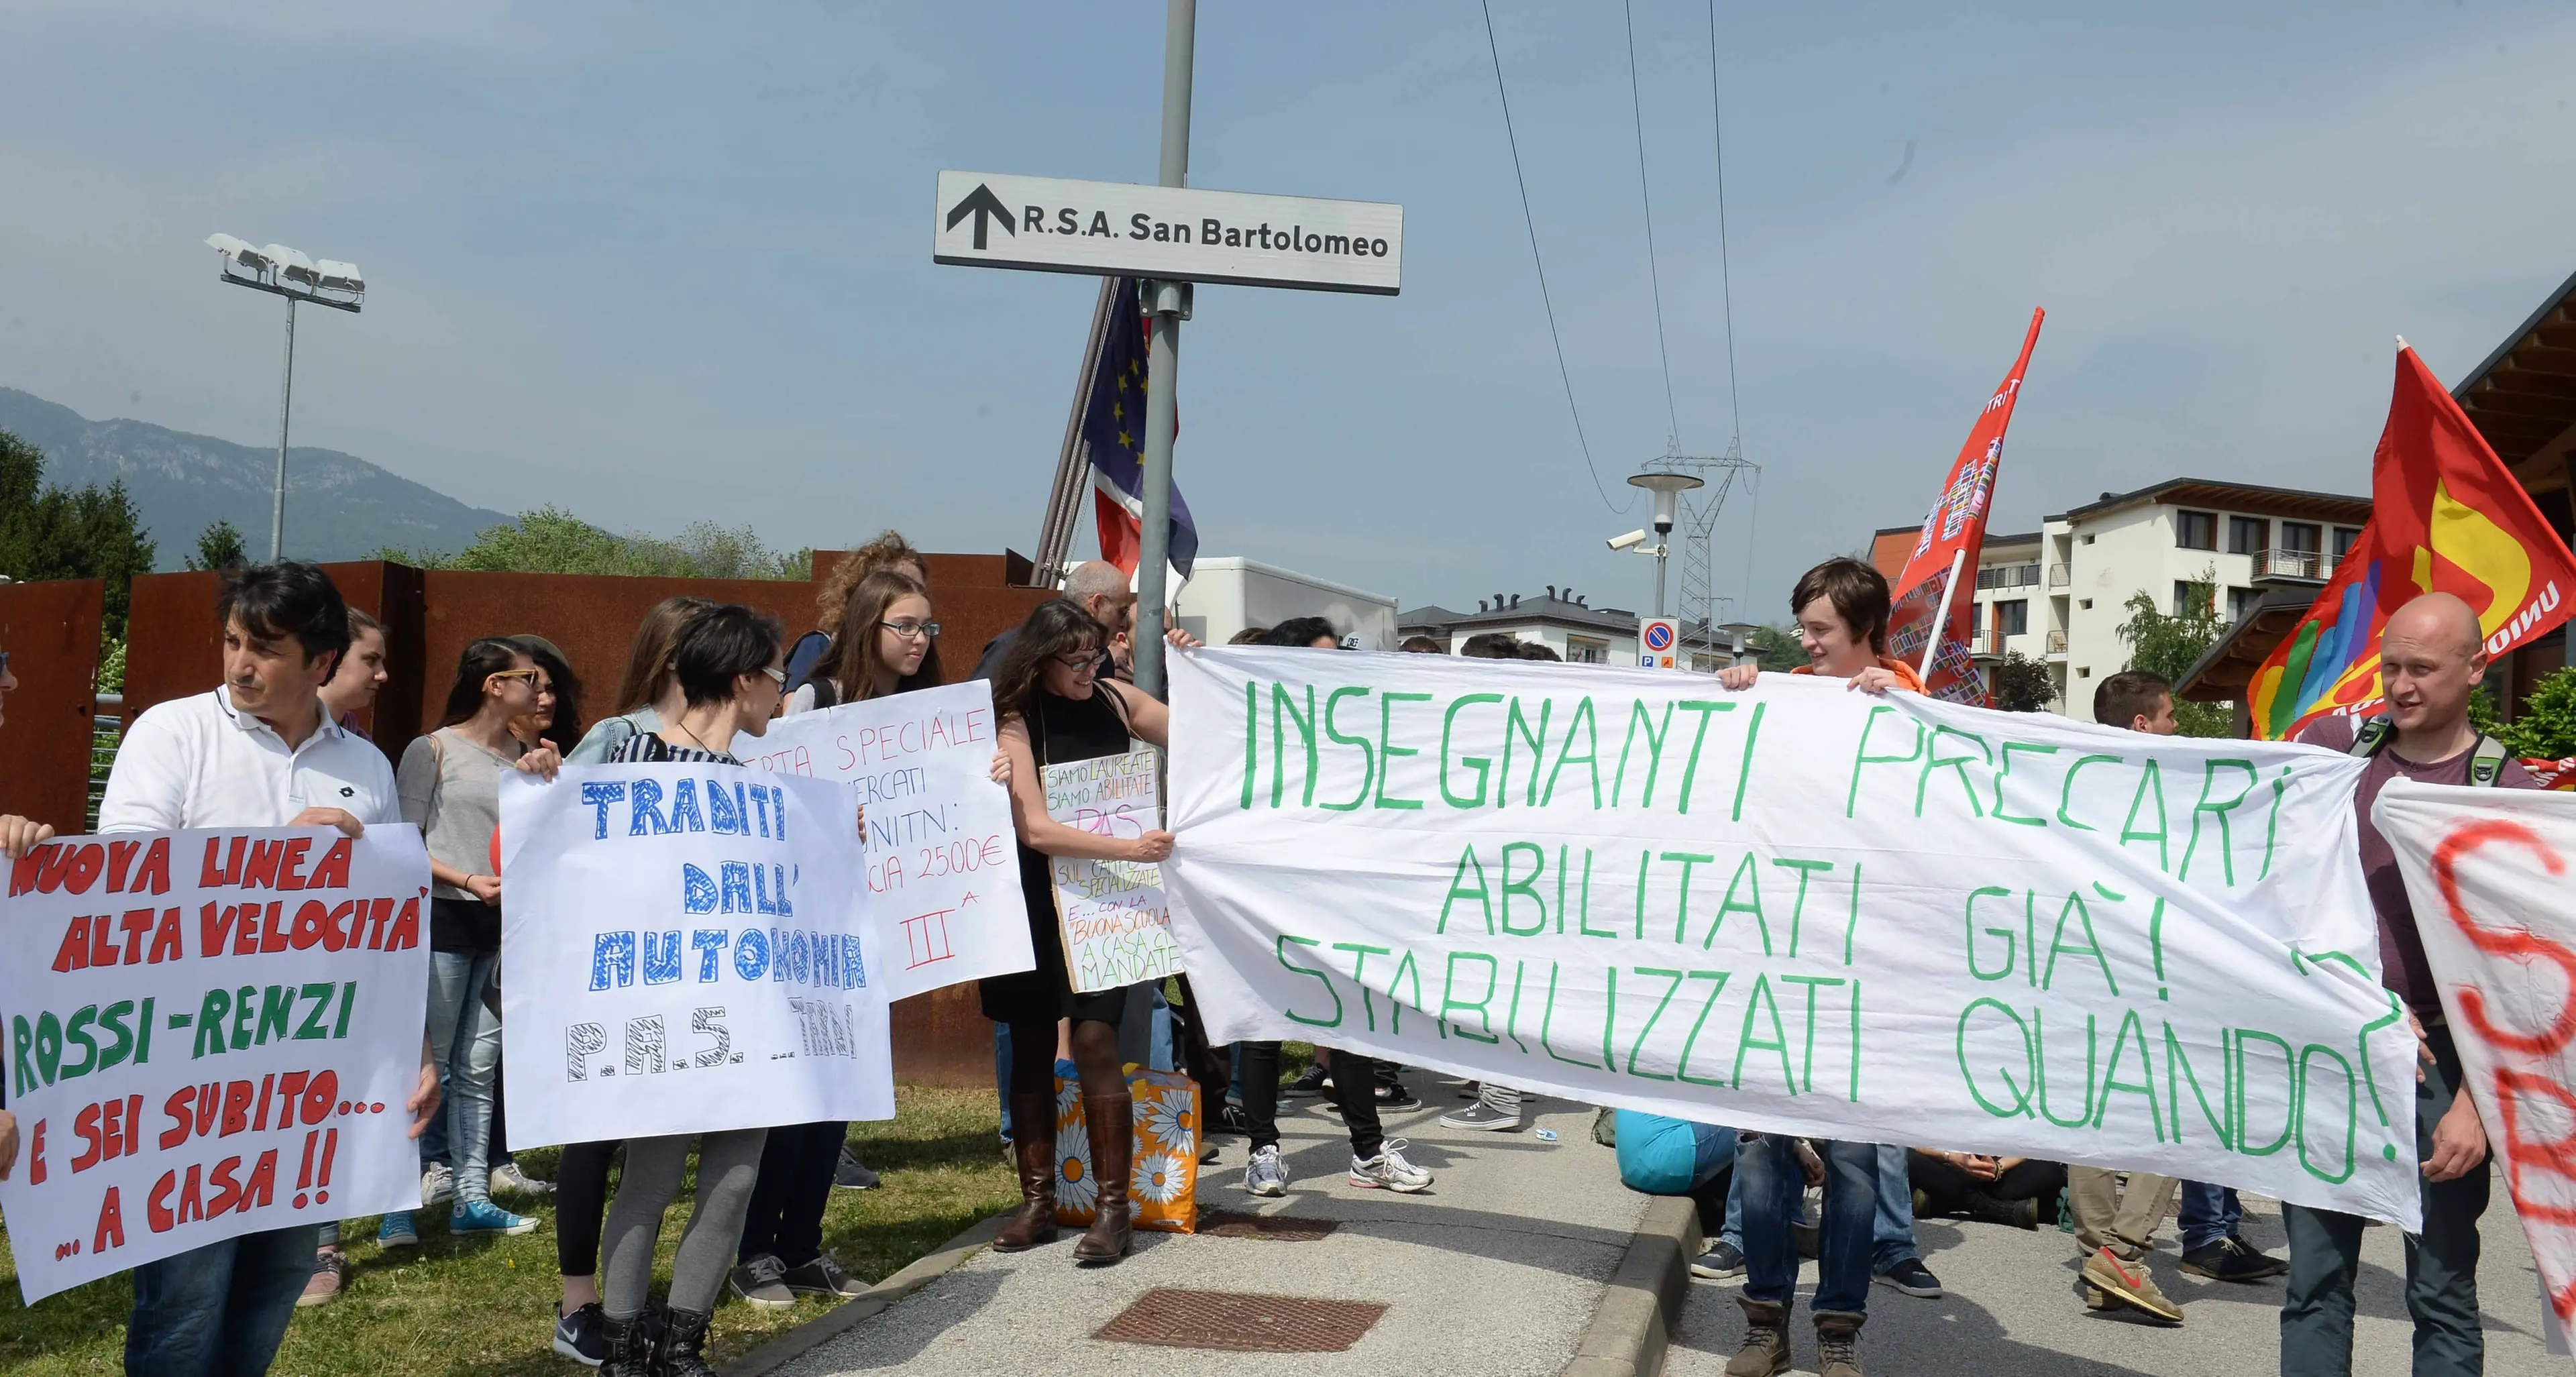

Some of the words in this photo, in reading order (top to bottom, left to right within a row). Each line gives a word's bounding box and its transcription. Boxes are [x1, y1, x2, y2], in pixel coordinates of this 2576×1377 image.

[1024, 205, 1119, 238] R.S.A.
[1129, 213, 1191, 244] San
[1201, 219, 1389, 258] Bartolomeo
[836, 709, 985, 771] SPECIALE
[848, 767, 926, 806] ERCATI
[1047, 767, 1087, 788] SIAMO
[1091, 751, 1154, 780] LAUREATE
[1048, 788, 1089, 811] SIAMO
[1095, 773, 1153, 803] ABILITATE
[1240, 678, 1766, 822] INSEGNANTI
[1847, 705, 2292, 887] PRECARI
[582, 778, 785, 841] TRADITI
[1075, 804, 1142, 837] PAS
[9, 837, 170, 897] NUOVA
[199, 836, 353, 890] LINEA
[918, 834, 1006, 879] 2500€
[1058, 863, 1081, 885] SUL
[684, 861, 799, 917] DALL'
[1076, 868, 1163, 899] SPECIALIZZATE
[1099, 900, 1122, 912] CON
[1130, 895, 1146, 907] LA
[1437, 842, 1862, 965] ABILITATI
[52, 907, 183, 973] ALTA
[1124, 907, 1171, 933] SCUOLA
[588, 928, 866, 992] AUTONOMIA
[1082, 942, 1095, 962] A
[1103, 932, 1148, 960] CASA
[1082, 946, 1181, 990] MANDATE
[566, 1006, 743, 1082] P.A.S.
[1277, 935, 1860, 1102] STABILIZZATI
[1957, 950, 2402, 1185] QUANDO?
[30, 1119, 46, 1186] E
[71, 1094, 144, 1174] SEI
